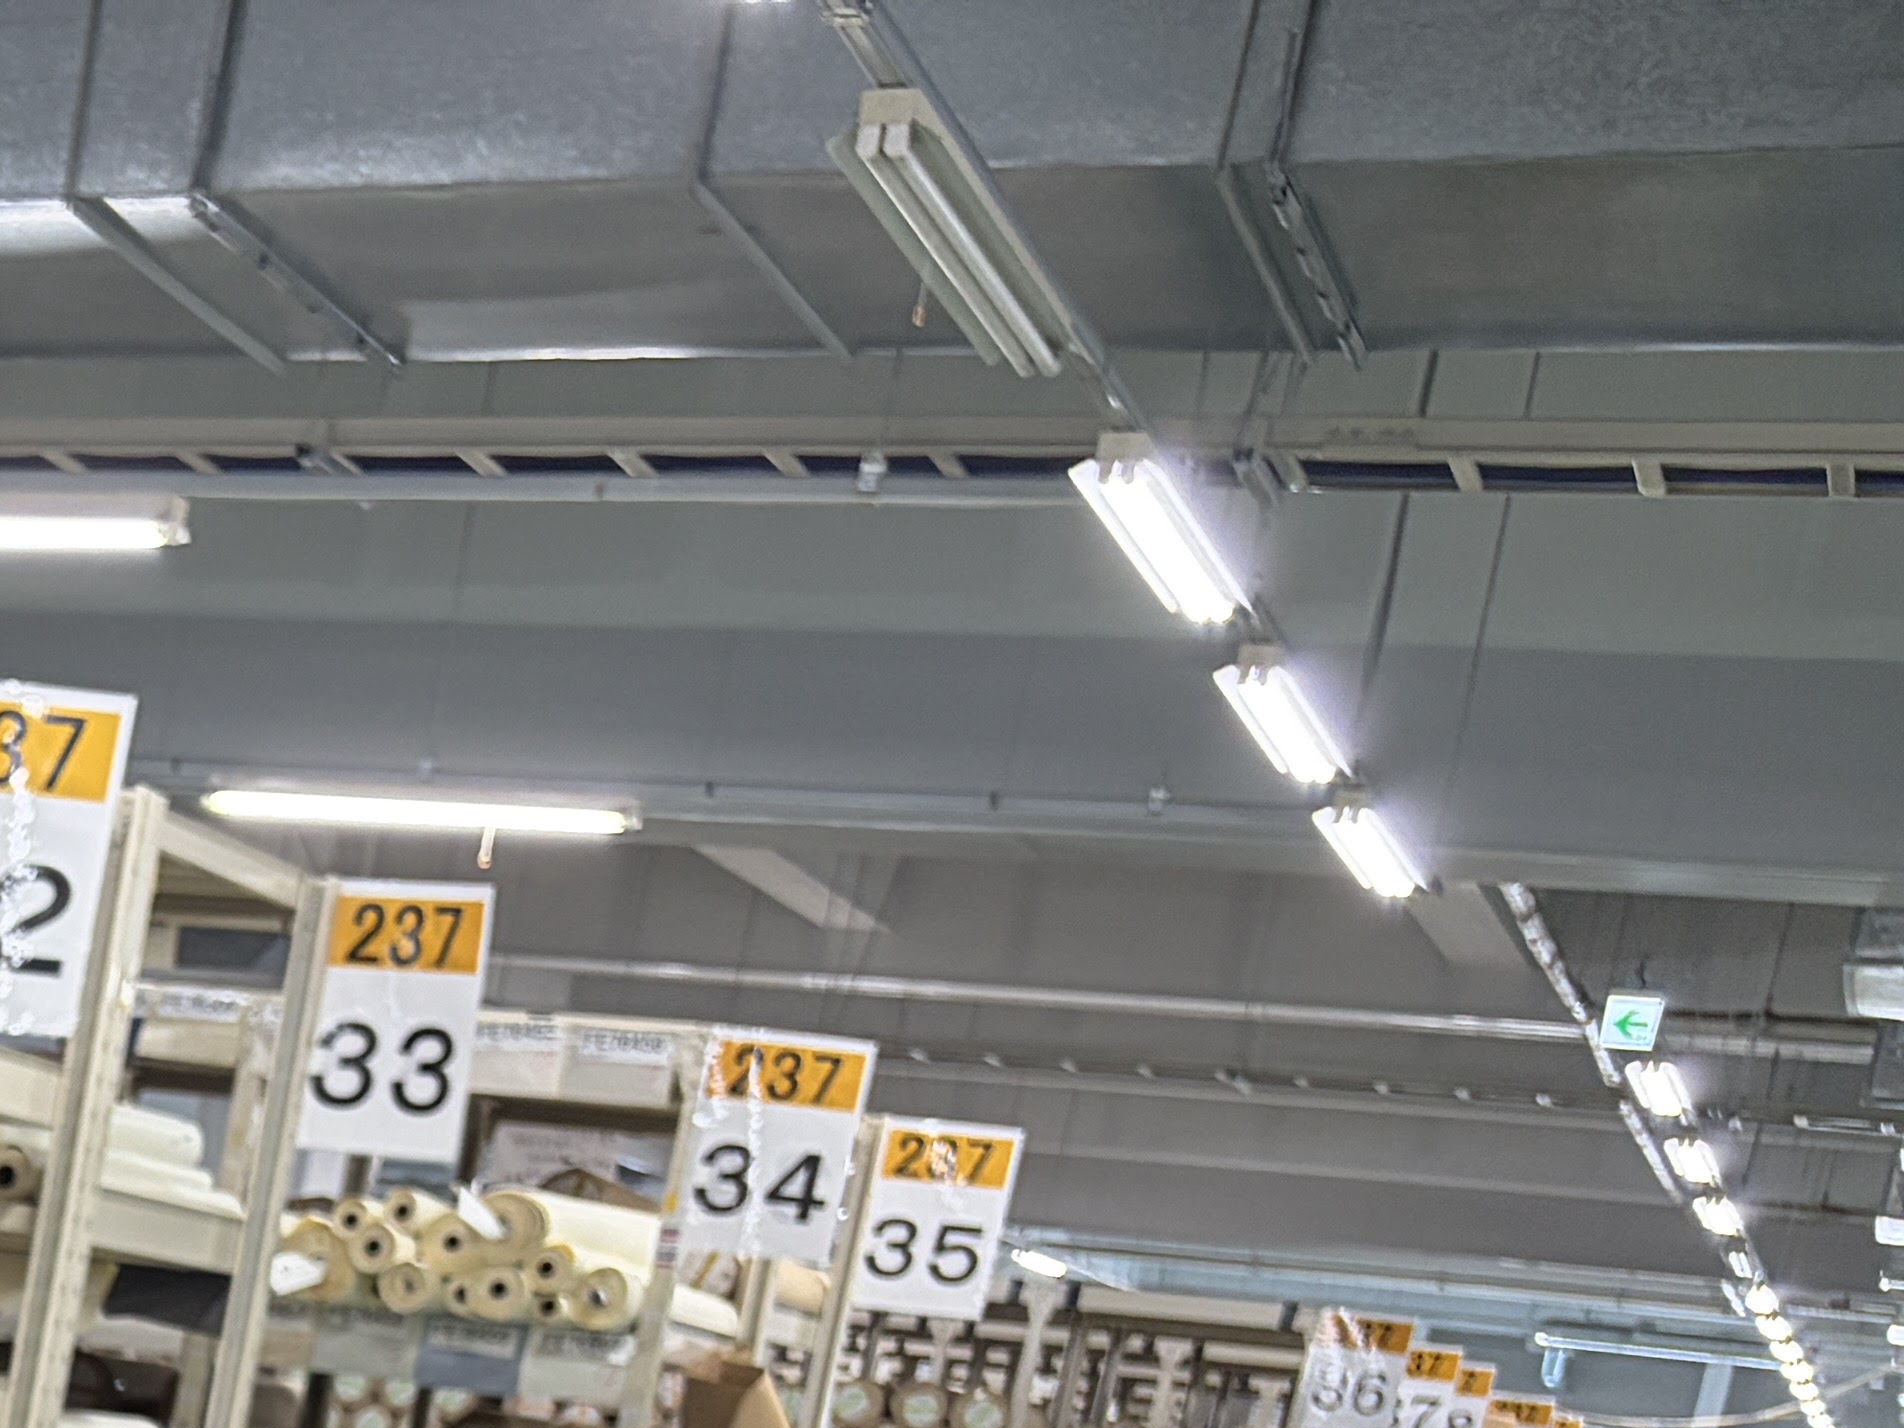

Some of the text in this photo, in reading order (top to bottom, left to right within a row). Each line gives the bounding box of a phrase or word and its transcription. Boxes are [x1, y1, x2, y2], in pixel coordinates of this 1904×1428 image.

[344, 901, 465, 968] 237
[309, 1020, 454, 1116] 33
[728, 1043, 843, 1103] 237
[694, 1144, 826, 1223] 34
[866, 1218, 984, 1283] 35
